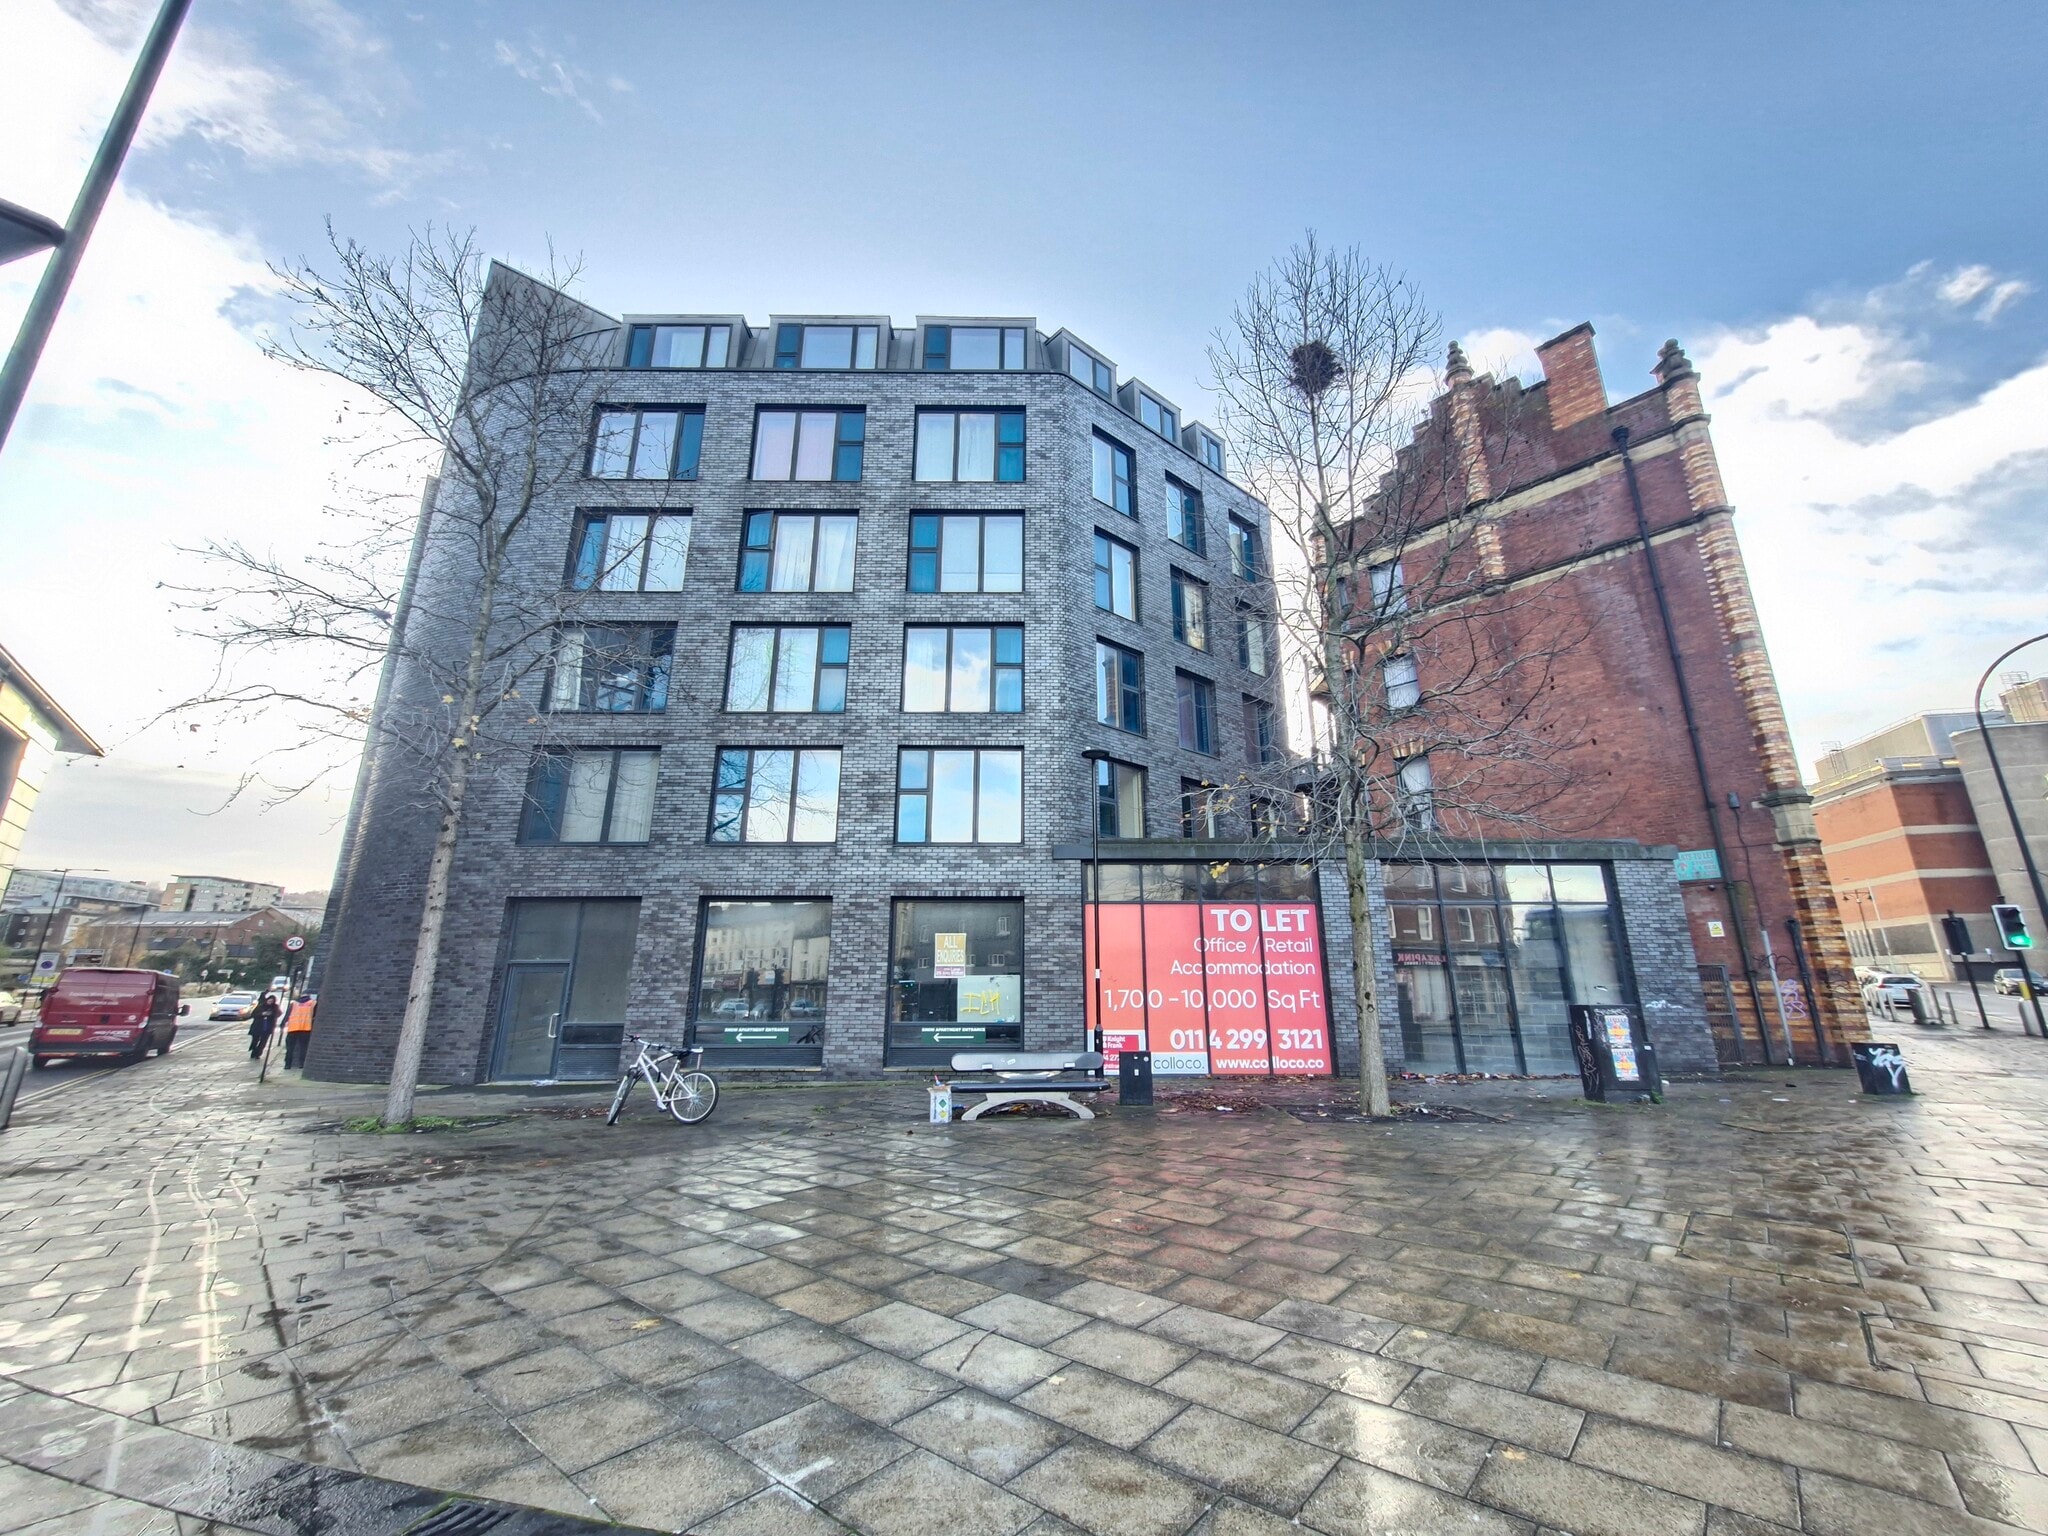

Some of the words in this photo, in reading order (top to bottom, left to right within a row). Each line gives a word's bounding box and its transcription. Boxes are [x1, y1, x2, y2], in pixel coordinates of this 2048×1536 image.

[1210, 909, 1252, 932] TO
[1261, 909, 1309, 932] LET
[288, 939, 303, 947] 20
[943, 936, 958, 949] ALL
[1193, 937, 1247, 953] Office
[1265, 937, 1313, 953] Retail
[1170, 959, 1316, 975] Accommodation
[1104, 989, 1163, 1011] 1,700
[1268, 990, 1297, 1013] Sq
[1300, 990, 1320, 1009] Ft
[1107, 1035, 1126, 1044] Knight
[1169, 1029, 1223, 1050] 0114
[1226, 1029, 1267, 1049] 299
[1278, 1029, 1323, 1049] 3121
[1216, 1057, 1325, 1069] www.colloco.co
